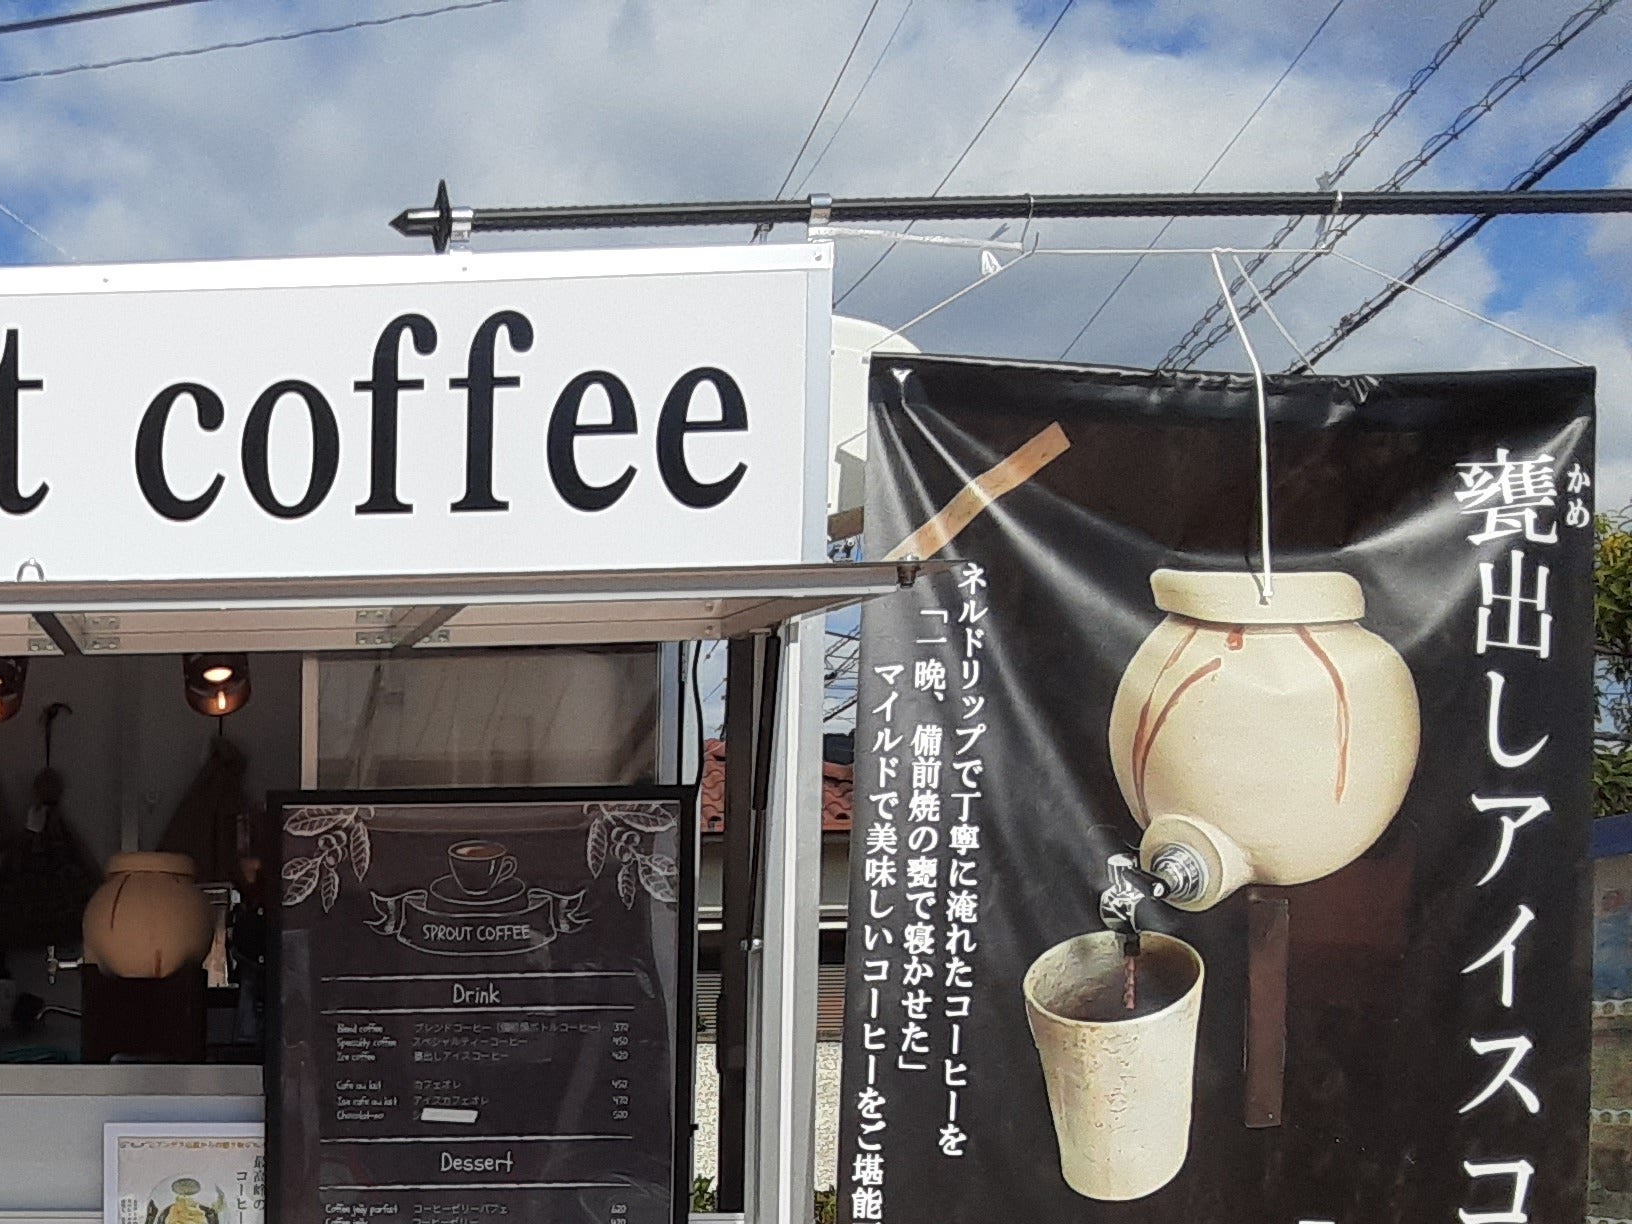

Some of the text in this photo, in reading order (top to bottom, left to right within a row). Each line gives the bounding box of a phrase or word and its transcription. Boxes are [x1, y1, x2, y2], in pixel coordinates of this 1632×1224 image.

[134, 310, 749, 521] coffee
[1565, 464, 1591, 529] かめ
[937, 563, 989, 1156] ネルドリップで丁寧に淹れたコーヒーを
[422, 924, 531, 941] SPROUT COFFEE
[452, 982, 501, 1005] Drink
[440, 1151, 514, 1174] Dessert
